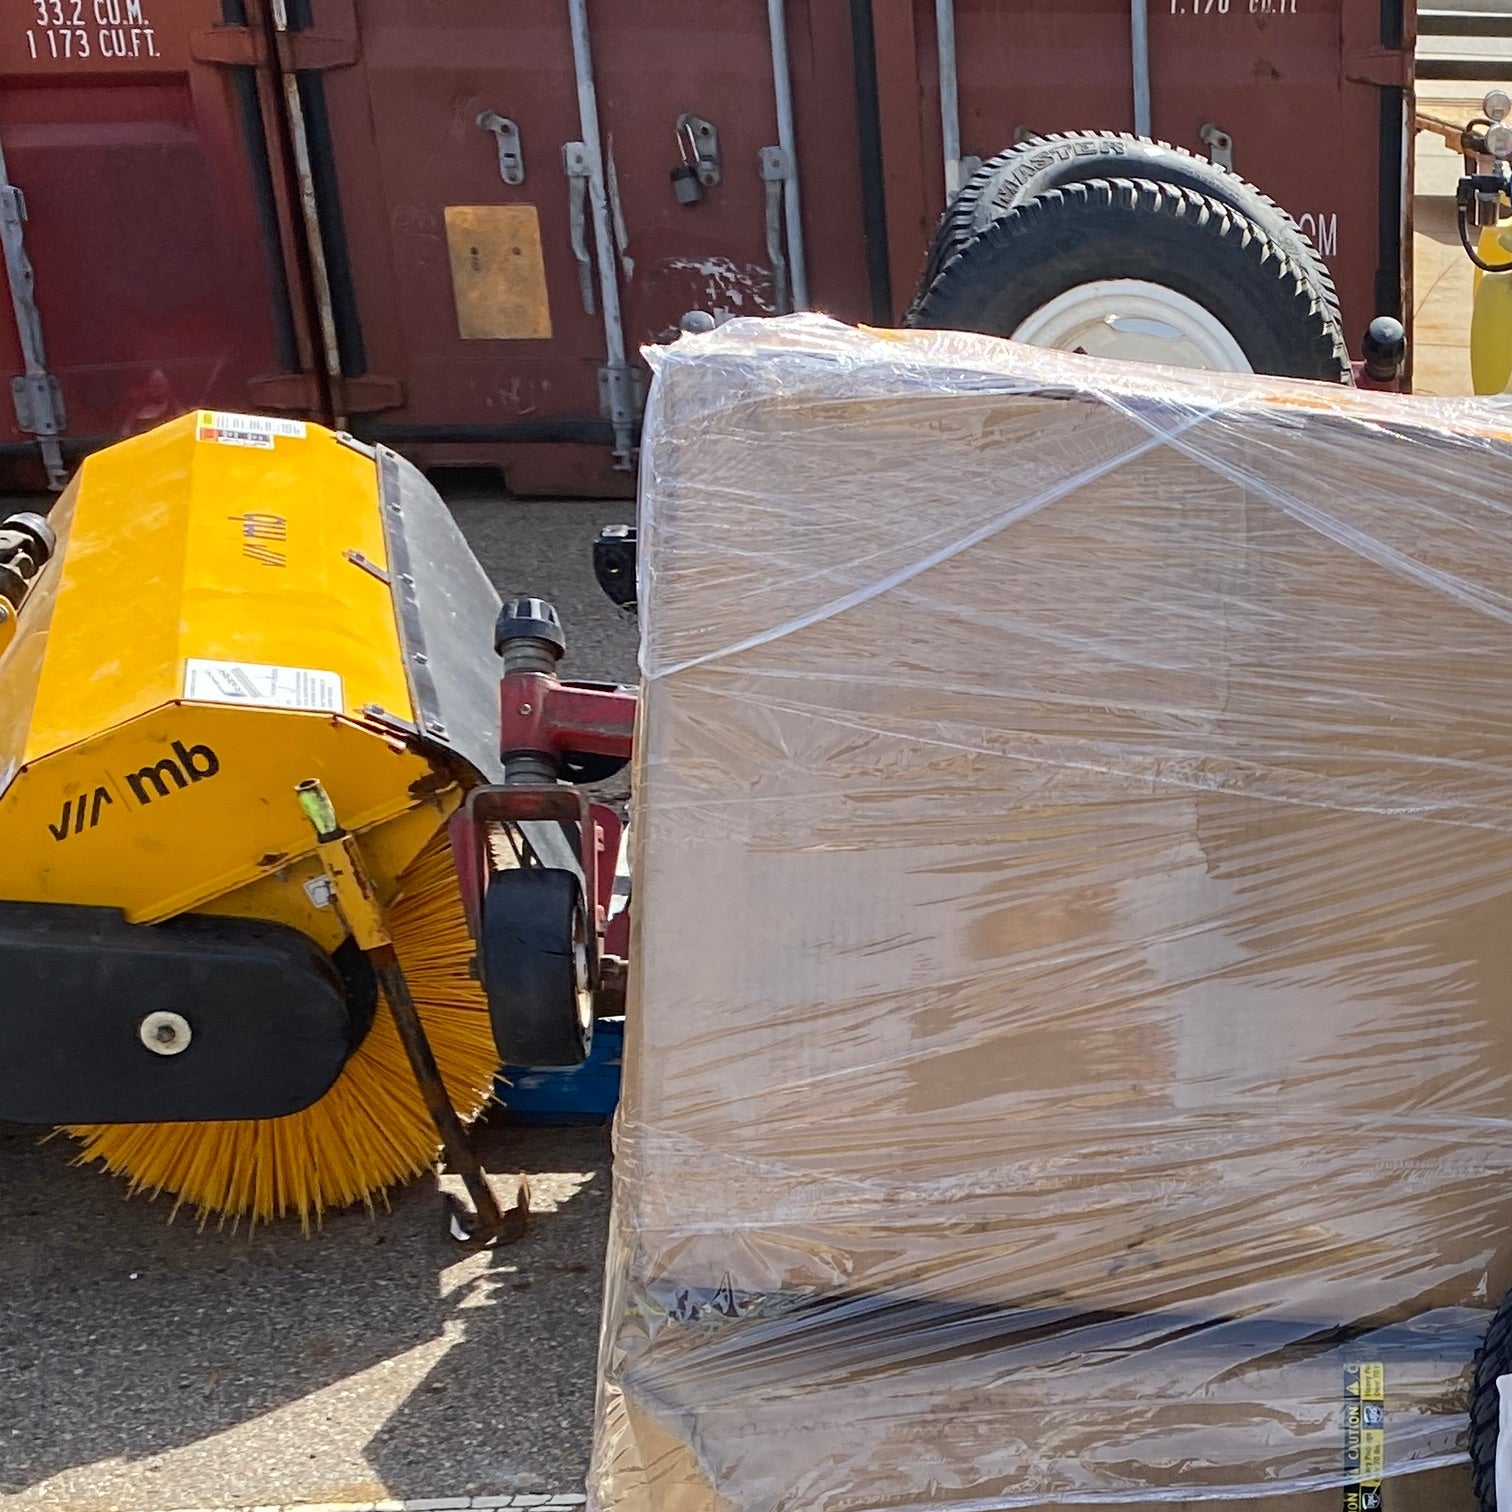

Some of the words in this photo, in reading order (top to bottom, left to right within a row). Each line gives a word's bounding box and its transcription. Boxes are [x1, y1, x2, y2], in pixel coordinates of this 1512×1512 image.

[33, 0, 86, 26] 33.2
[100, 28, 161, 58] CU.FT.
[125, 739, 220, 806] mb
[1347, 1405, 1360, 1460] CAUTION
